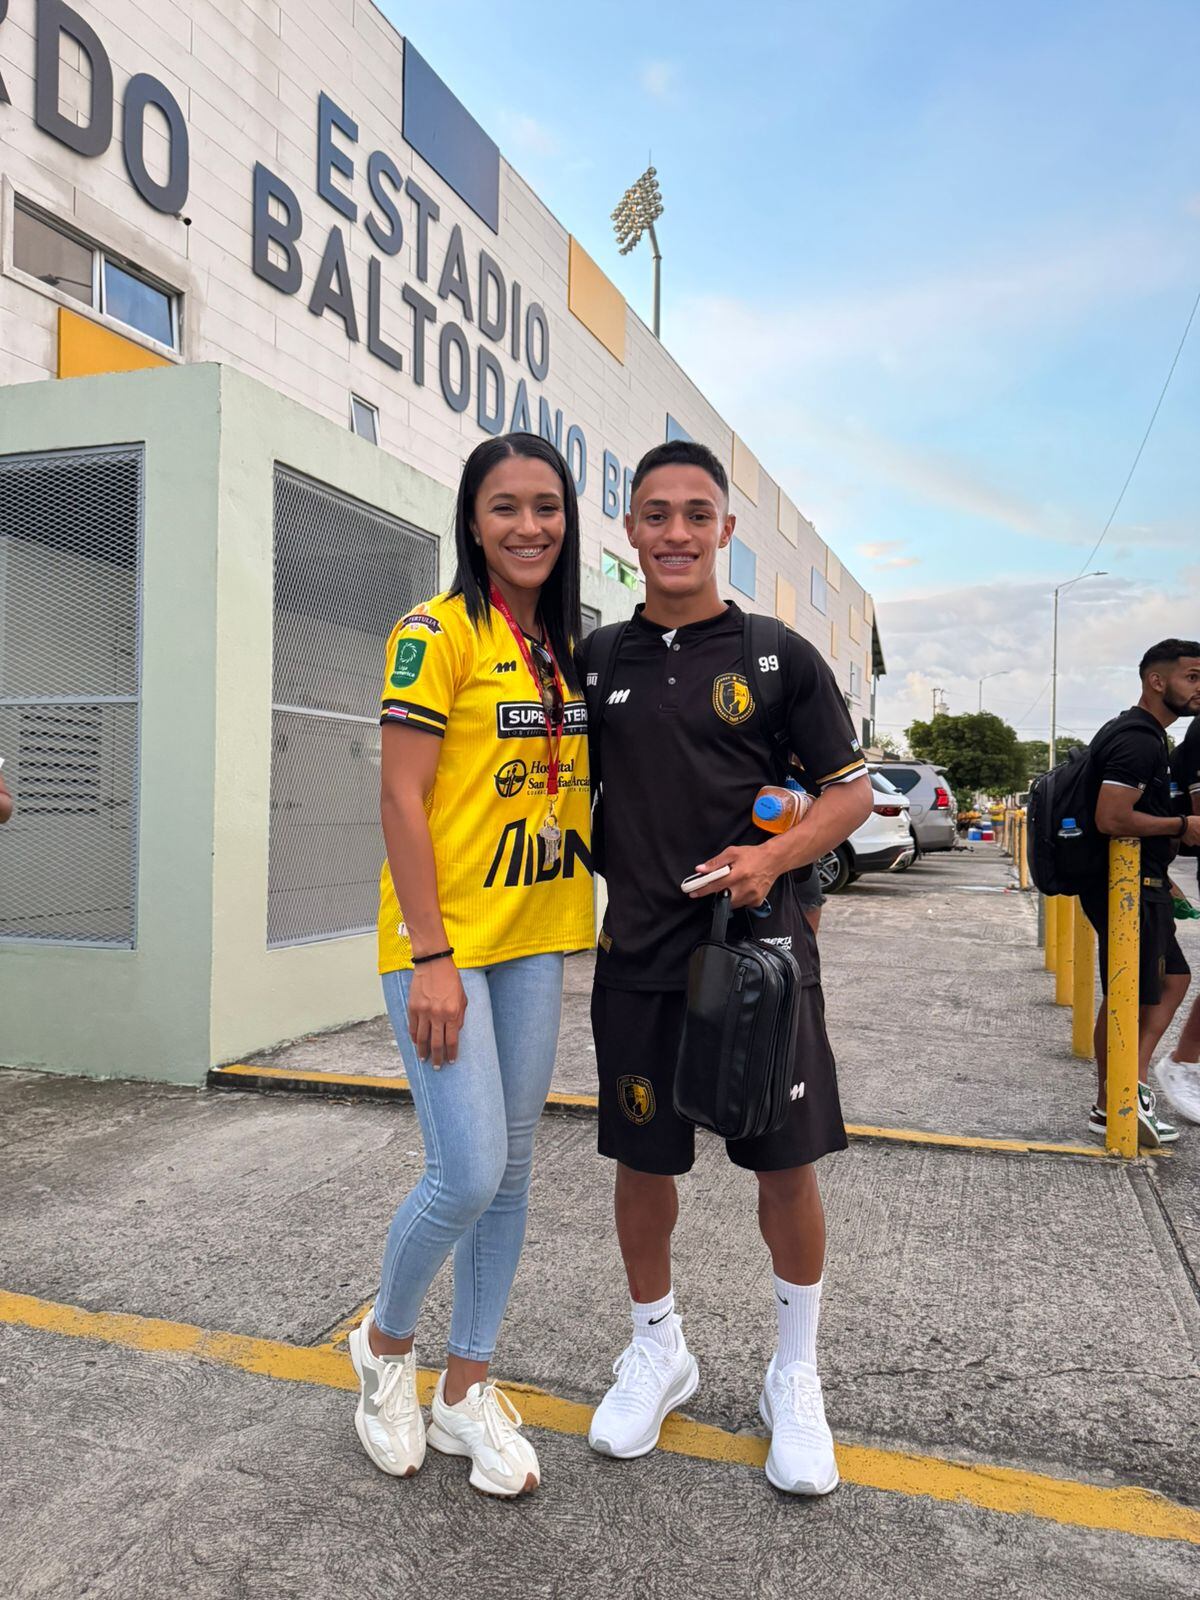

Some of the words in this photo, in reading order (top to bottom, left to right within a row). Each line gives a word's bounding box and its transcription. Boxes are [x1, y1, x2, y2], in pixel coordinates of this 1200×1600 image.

[0, 0, 190, 216] DO
[252, 160, 587, 497] BALTODANO
[316, 91, 550, 382] ESTADIO
[758, 654, 779, 673] 99
[528, 778, 545, 790] San
